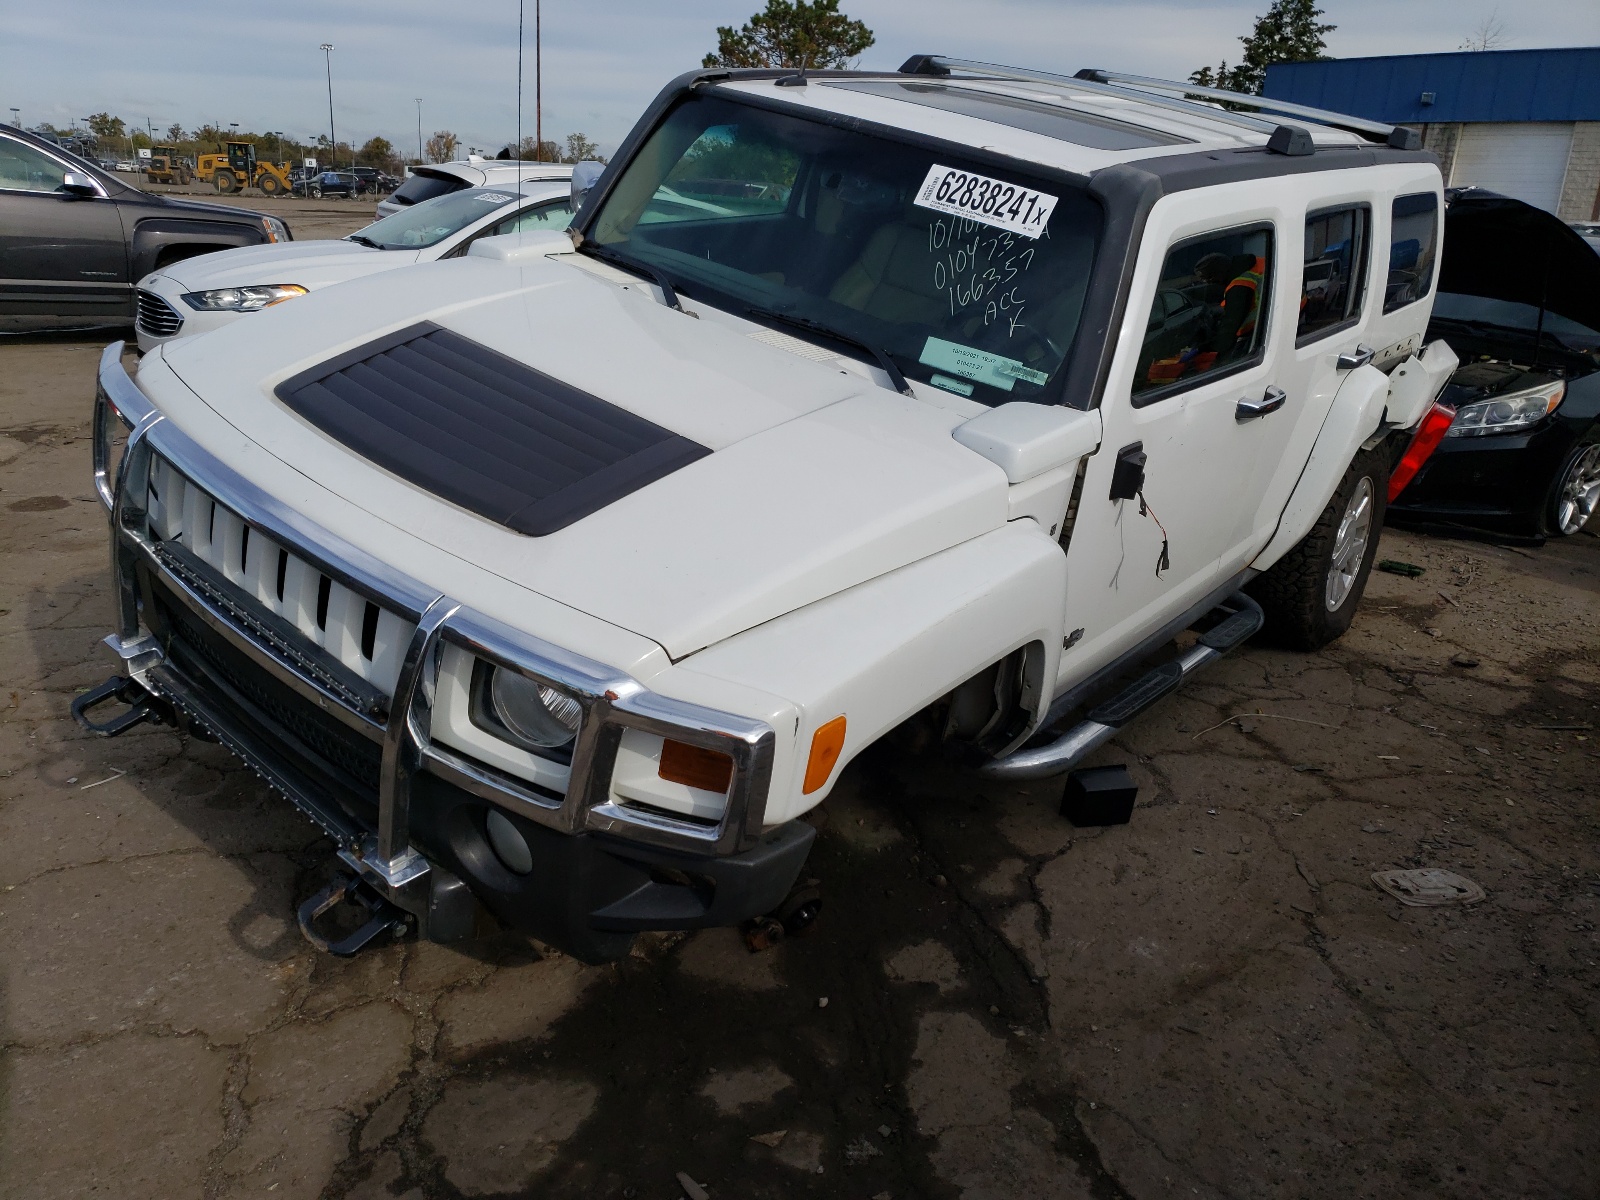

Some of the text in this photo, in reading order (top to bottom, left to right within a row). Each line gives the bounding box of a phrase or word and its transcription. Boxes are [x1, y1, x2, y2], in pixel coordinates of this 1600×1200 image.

[936, 171, 1040, 226] 62838241
[984, 286, 1026, 326] ACC
[1008, 306, 1026, 338] K
